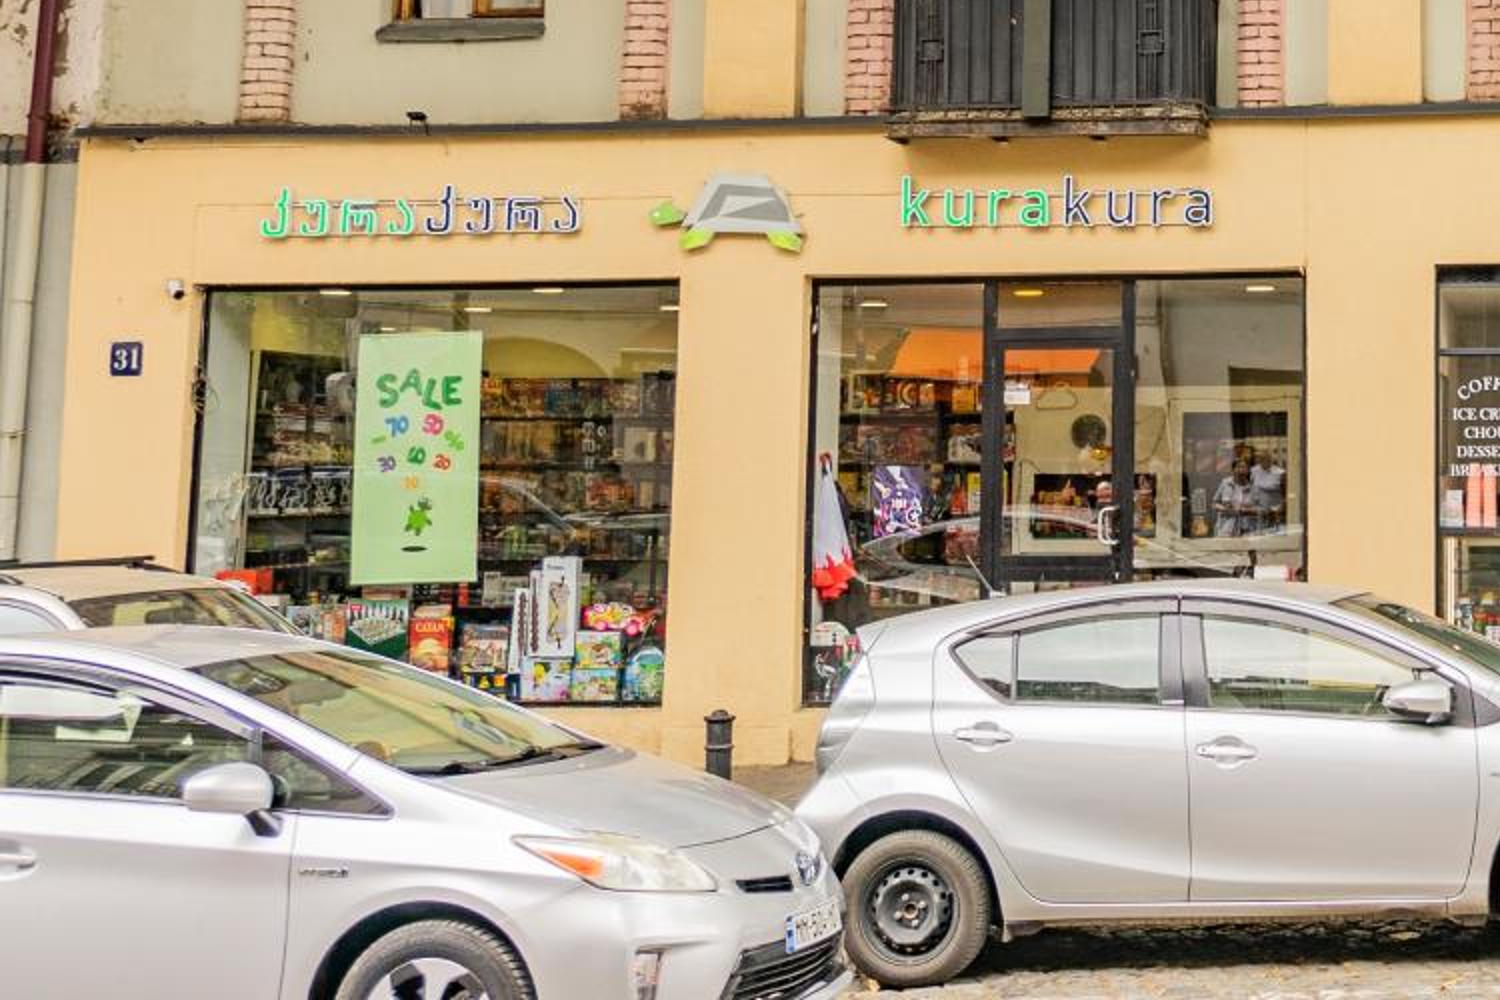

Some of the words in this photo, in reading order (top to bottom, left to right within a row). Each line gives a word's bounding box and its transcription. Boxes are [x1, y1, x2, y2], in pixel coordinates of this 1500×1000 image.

[260, 184, 583, 238] კურაკურა
[901, 175, 1214, 228] kurakura
[113, 349, 138, 371] 31
[376, 369, 463, 410] SALE
[385, 415, 409, 438] 70
[1453, 407, 1477, 421] ICE
